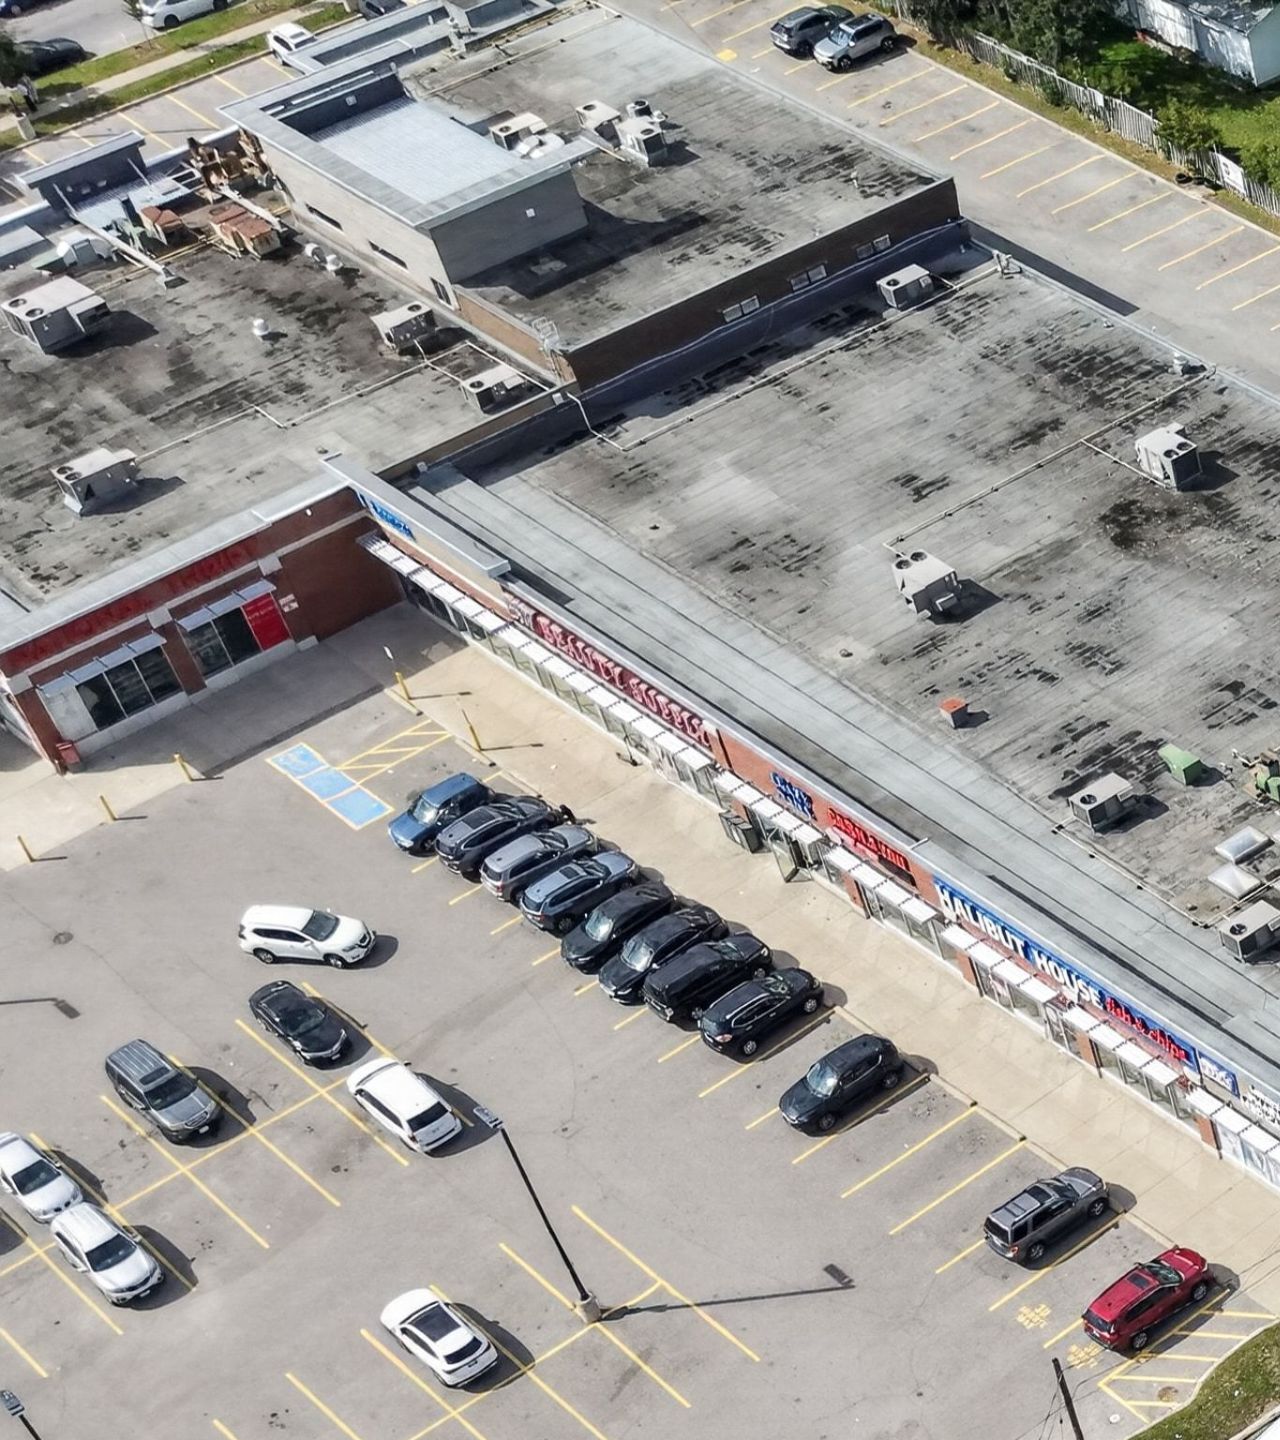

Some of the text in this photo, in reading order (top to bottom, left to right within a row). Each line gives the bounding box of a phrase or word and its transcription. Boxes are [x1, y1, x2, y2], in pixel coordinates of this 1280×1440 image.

[935, 884, 1026, 957] HALIBUT
[1033, 952, 1104, 1009] HOUSE
[1149, 1027, 1186, 1061] chips
